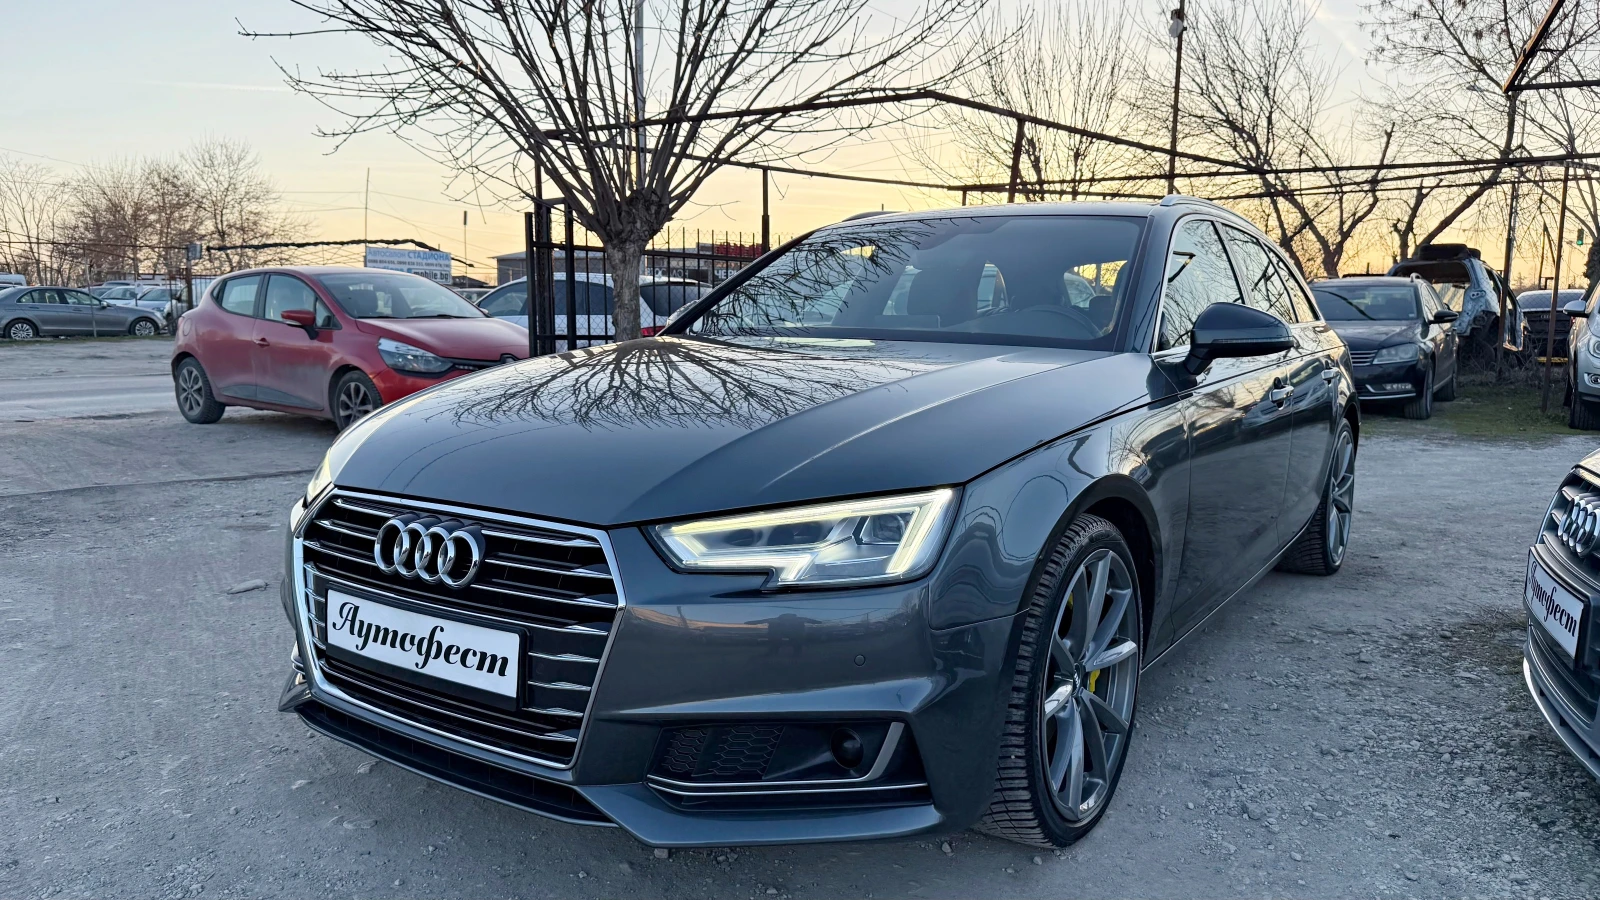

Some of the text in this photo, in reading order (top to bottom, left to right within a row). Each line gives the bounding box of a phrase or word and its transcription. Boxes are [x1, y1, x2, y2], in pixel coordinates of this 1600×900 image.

[368, 249, 450, 261] Автосалон СТАДИОНА
[1528, 560, 1578, 637] Аутофест
[332, 601, 509, 677] Аутофест
